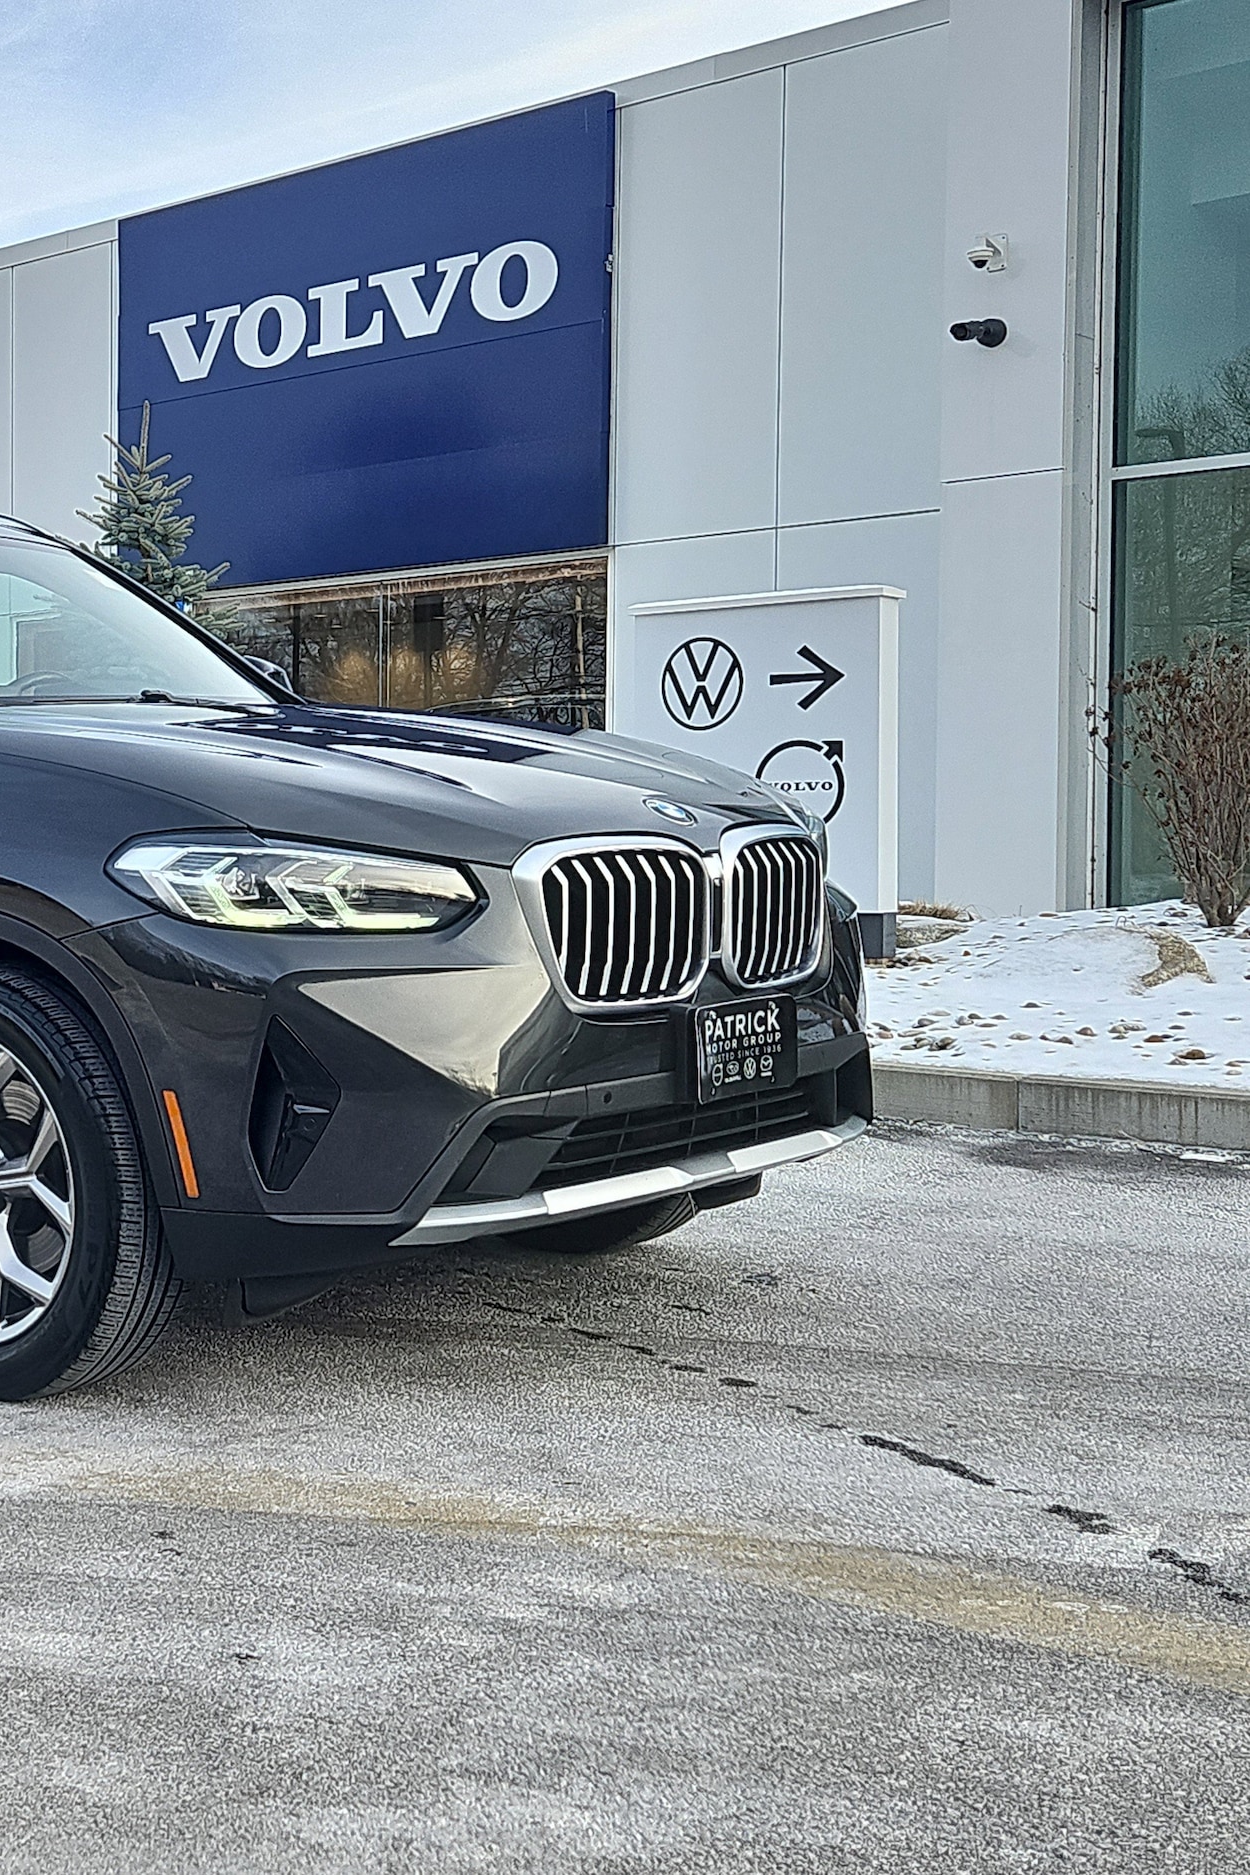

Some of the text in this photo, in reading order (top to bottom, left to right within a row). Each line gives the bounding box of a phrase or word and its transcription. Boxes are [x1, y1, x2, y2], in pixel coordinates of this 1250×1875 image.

[149, 239, 559, 383] VOLVO
[704, 1008, 781, 1044] PATRICK
[742, 1032, 782, 1047] GROUP
[738, 1047, 760, 1059] SINCE
